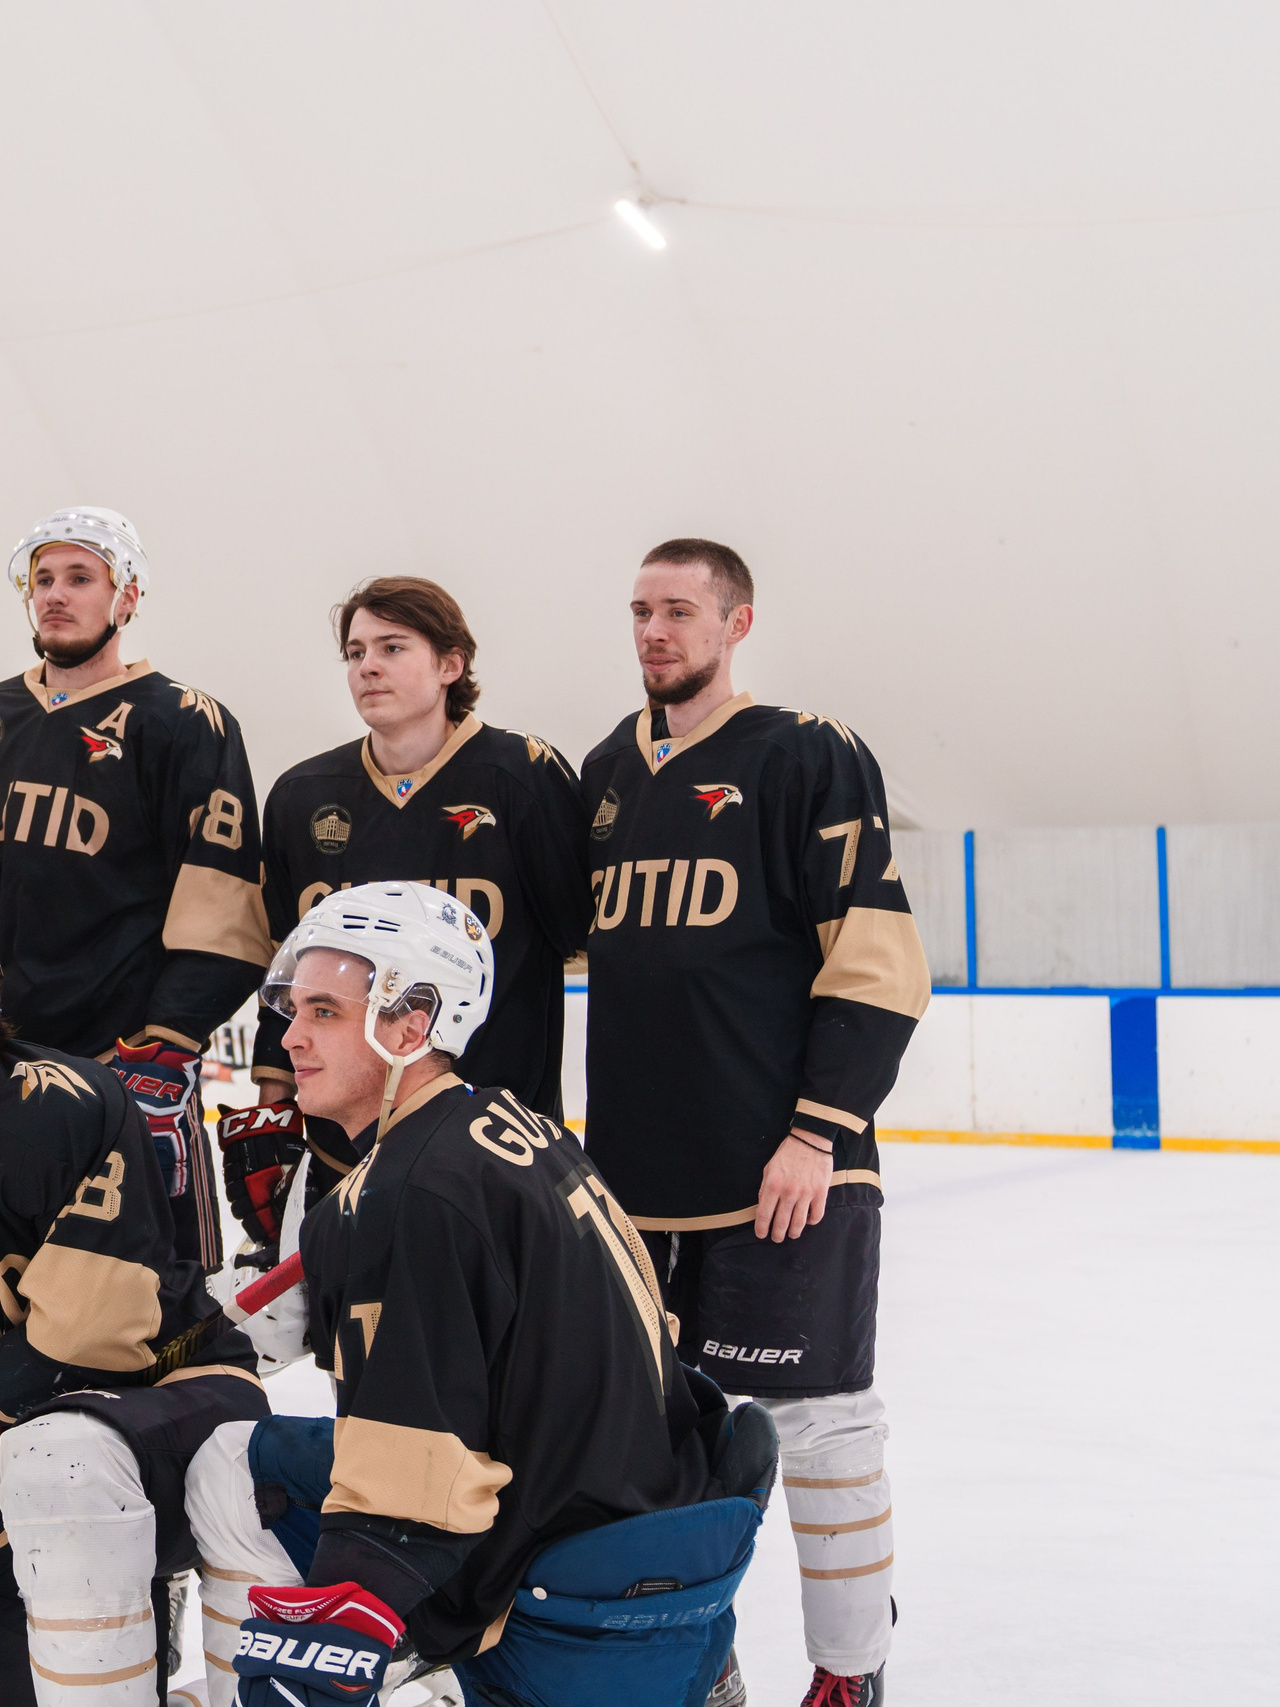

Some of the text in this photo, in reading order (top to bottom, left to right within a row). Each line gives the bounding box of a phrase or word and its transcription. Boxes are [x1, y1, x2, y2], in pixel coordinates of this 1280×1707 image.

[96, 701, 136, 740] A
[221, 1107, 295, 1139] CM
[702, 1339, 803, 1364] BAUER
[273, 1606, 318, 1615] FREE FLEX
[236, 1631, 380, 1679] BAUER
